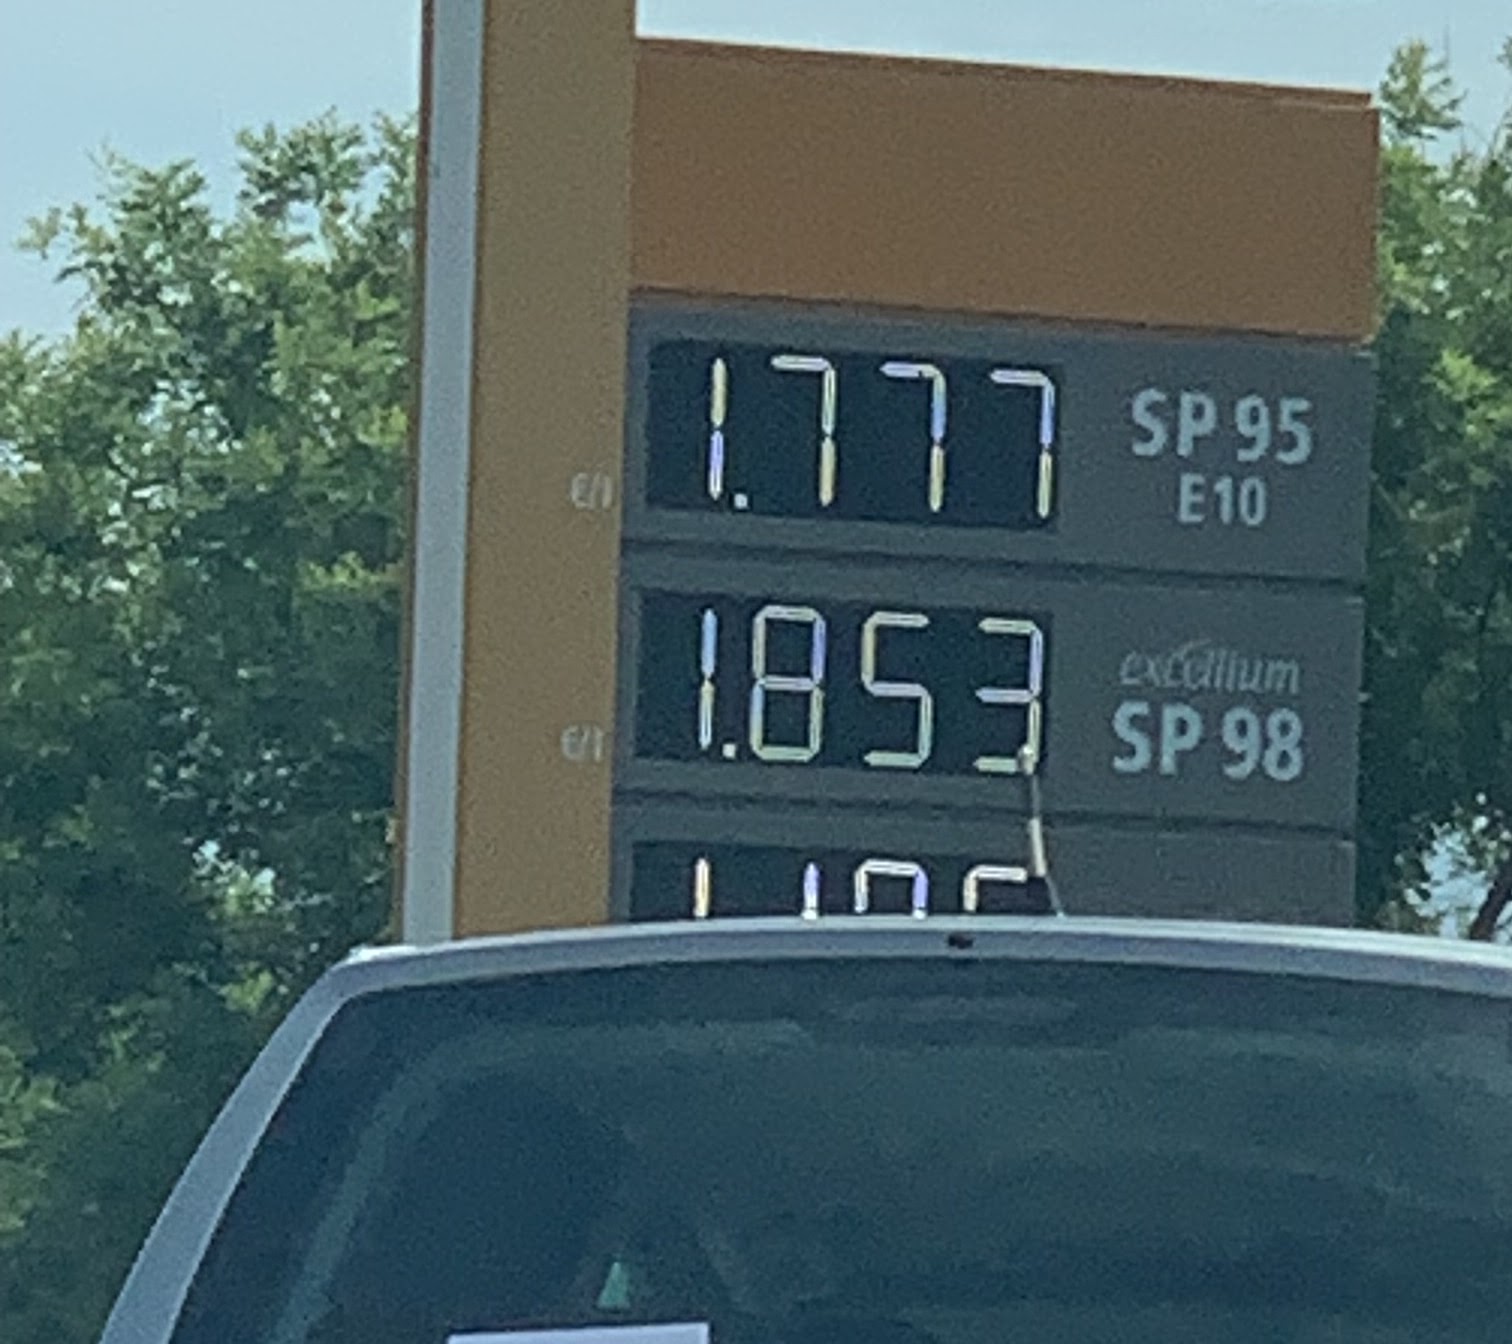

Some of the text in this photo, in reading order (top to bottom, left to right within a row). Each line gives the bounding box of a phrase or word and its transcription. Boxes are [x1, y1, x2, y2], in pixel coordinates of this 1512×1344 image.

[707, 352, 1057, 520] 1.777
[1131, 388, 1312, 464] SP 95
[1177, 473, 1267, 526] E10
[696, 605, 1044, 775] 1.853
[1113, 701, 1303, 782] SP 98
